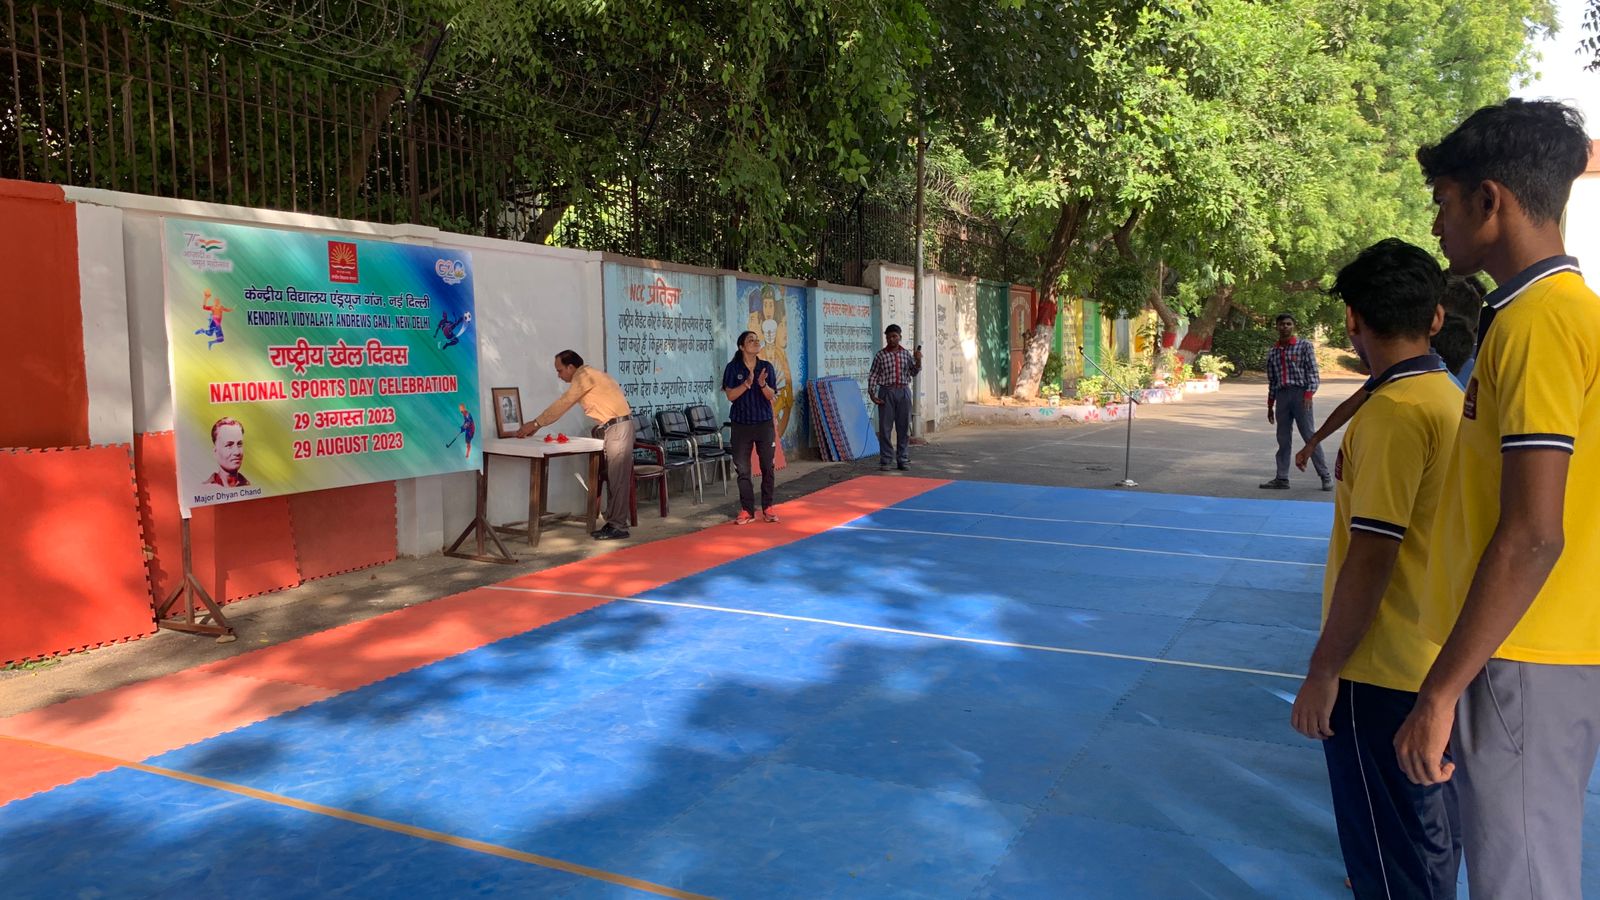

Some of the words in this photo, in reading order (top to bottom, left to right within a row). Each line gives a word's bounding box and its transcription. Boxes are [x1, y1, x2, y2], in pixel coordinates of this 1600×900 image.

[243, 285, 283, 303] केन्द्रीय
[286, 286, 327, 303] विद्यालय
[388, 293, 403, 309] नई
[405, 293, 430, 308] दिल्ली
[630, 283, 645, 303] NCC
[646, 277, 682, 309] प्रतिज्ञा
[247, 310, 290, 326] KENDRIYA
[291, 312, 334, 327] VIDYALAYA
[336, 313, 372, 328] ANDREWS
[395, 315, 410, 329] NEW
[412, 316, 430, 330] DELHI
[268, 338, 324, 374] राष्ट्रीय
[327, 339, 364, 366] खेल
[366, 339, 408, 365] दिवस
[209, 381, 288, 403] NATIONAL
[291, 379, 346, 399] SPORTS
[349, 378, 375, 396] DAY
[379, 376, 458, 395] CELEBRATION
[293, 413, 310, 430] 29
[314, 409, 364, 428] अगस्त
[367, 407, 395, 424] 2023
[293, 440, 312, 459] 29
[316, 435, 369, 457] AUGUST
[372, 432, 403, 451] 2023
[194, 494, 215, 503] Major
[216, 491, 239, 500] Dhyan
[239, 488, 262, 496] Chand
